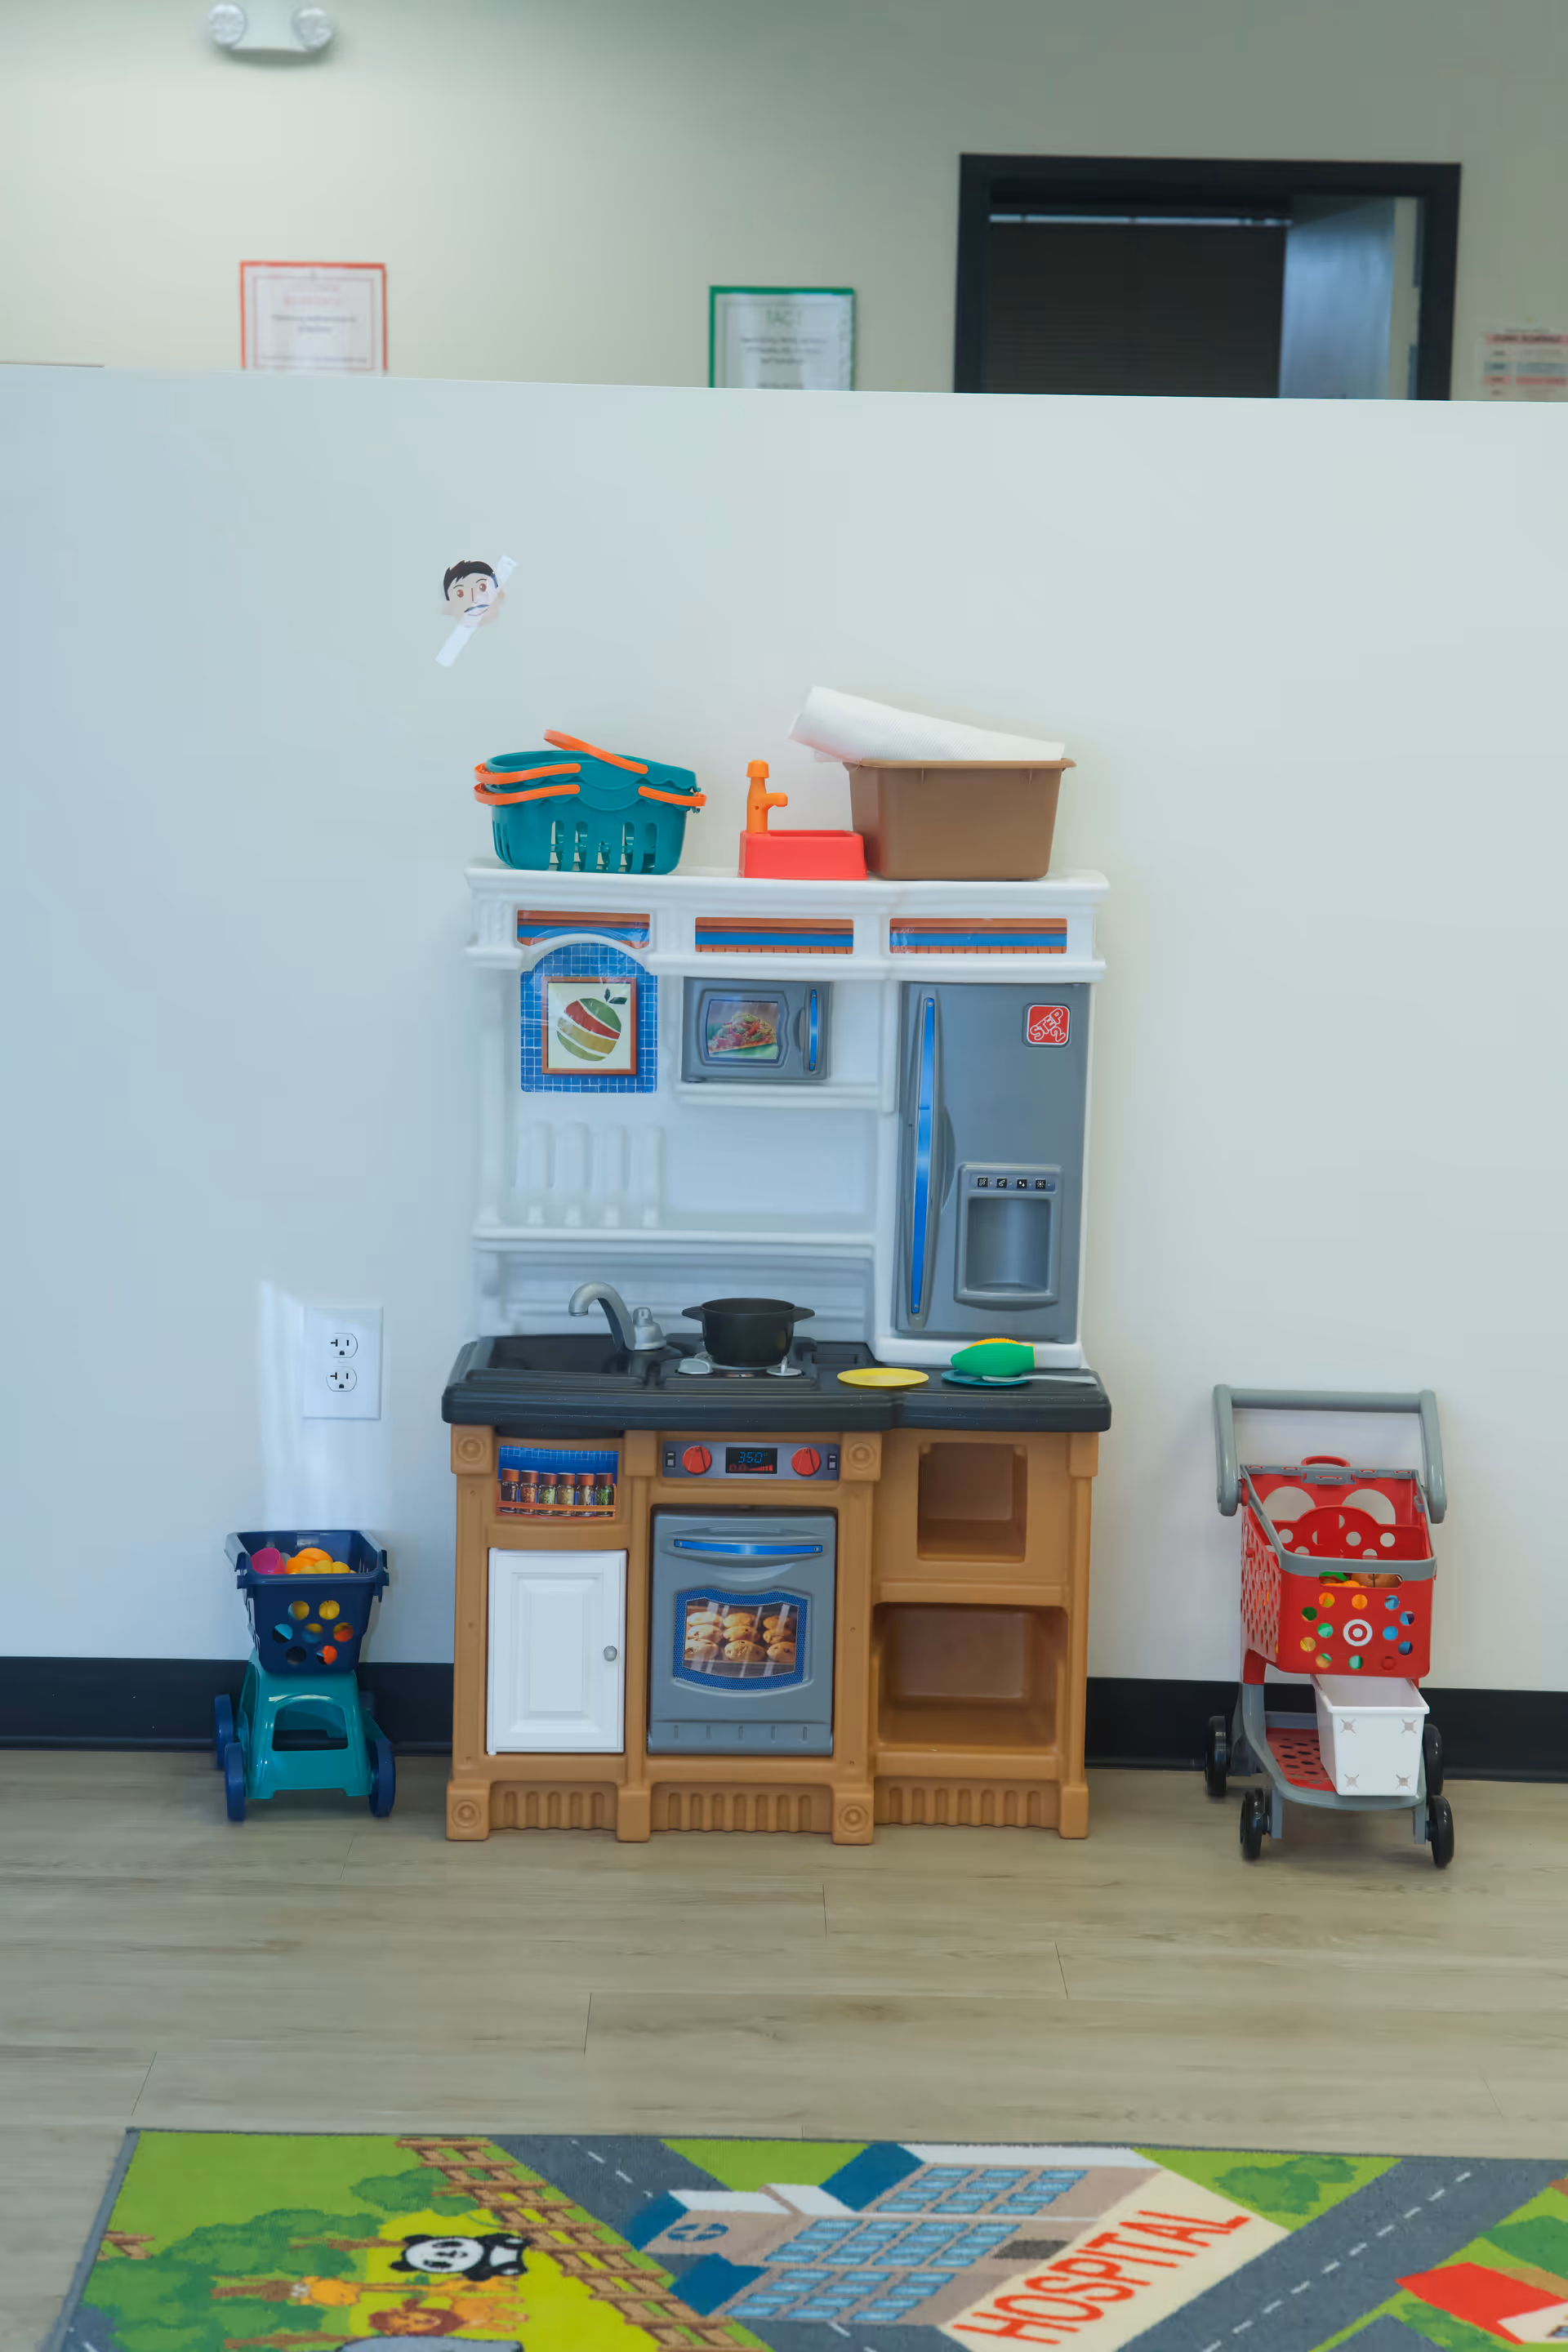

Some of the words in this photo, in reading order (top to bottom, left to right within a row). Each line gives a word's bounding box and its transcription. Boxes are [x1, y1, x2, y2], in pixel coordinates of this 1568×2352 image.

[1031, 1008, 1063, 1040] STEP
[1050, 1027, 1066, 1042] 2
[953, 2210, 1251, 2345] HOSPITAL
